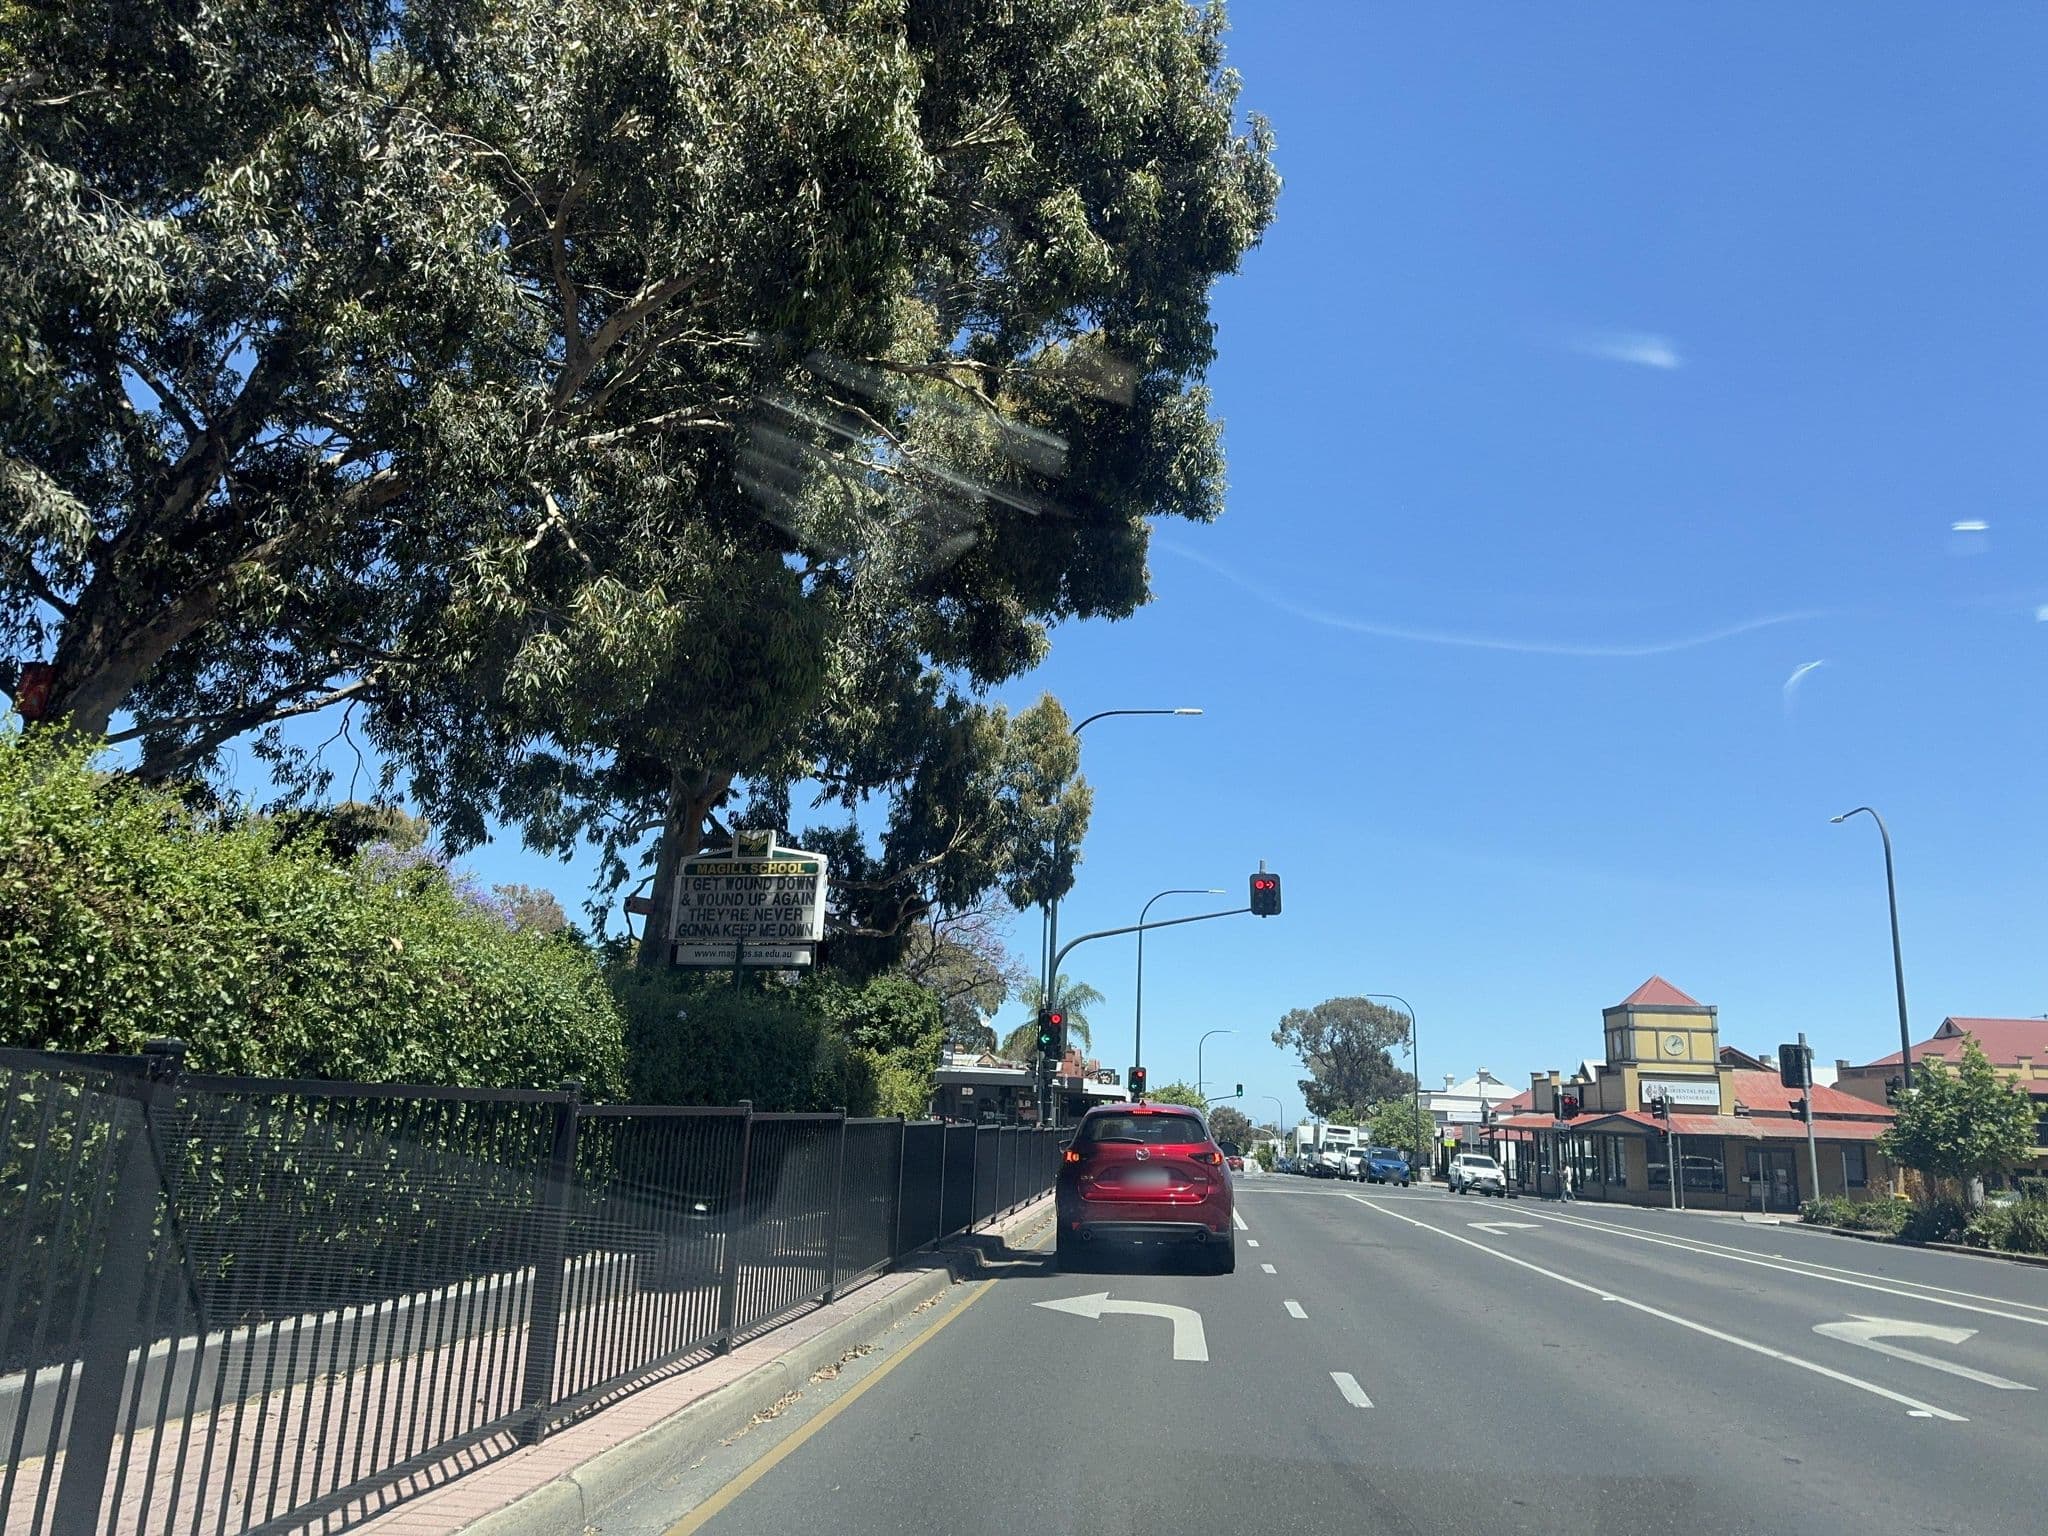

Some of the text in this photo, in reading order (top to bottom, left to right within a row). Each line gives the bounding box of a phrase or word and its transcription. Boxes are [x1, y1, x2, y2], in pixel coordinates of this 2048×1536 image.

[696, 863, 806, 874] MAGILL SCHOOL
[692, 877, 720, 891] GET
[725, 877, 772, 891] WOUND
[776, 877, 816, 890] DOWN
[681, 892, 815, 907] & WOUND UP AGAIN
[689, 907, 803, 922] THEY'RE NEVER
[679, 923, 813, 937] GONNA KEEP ME DOWN
